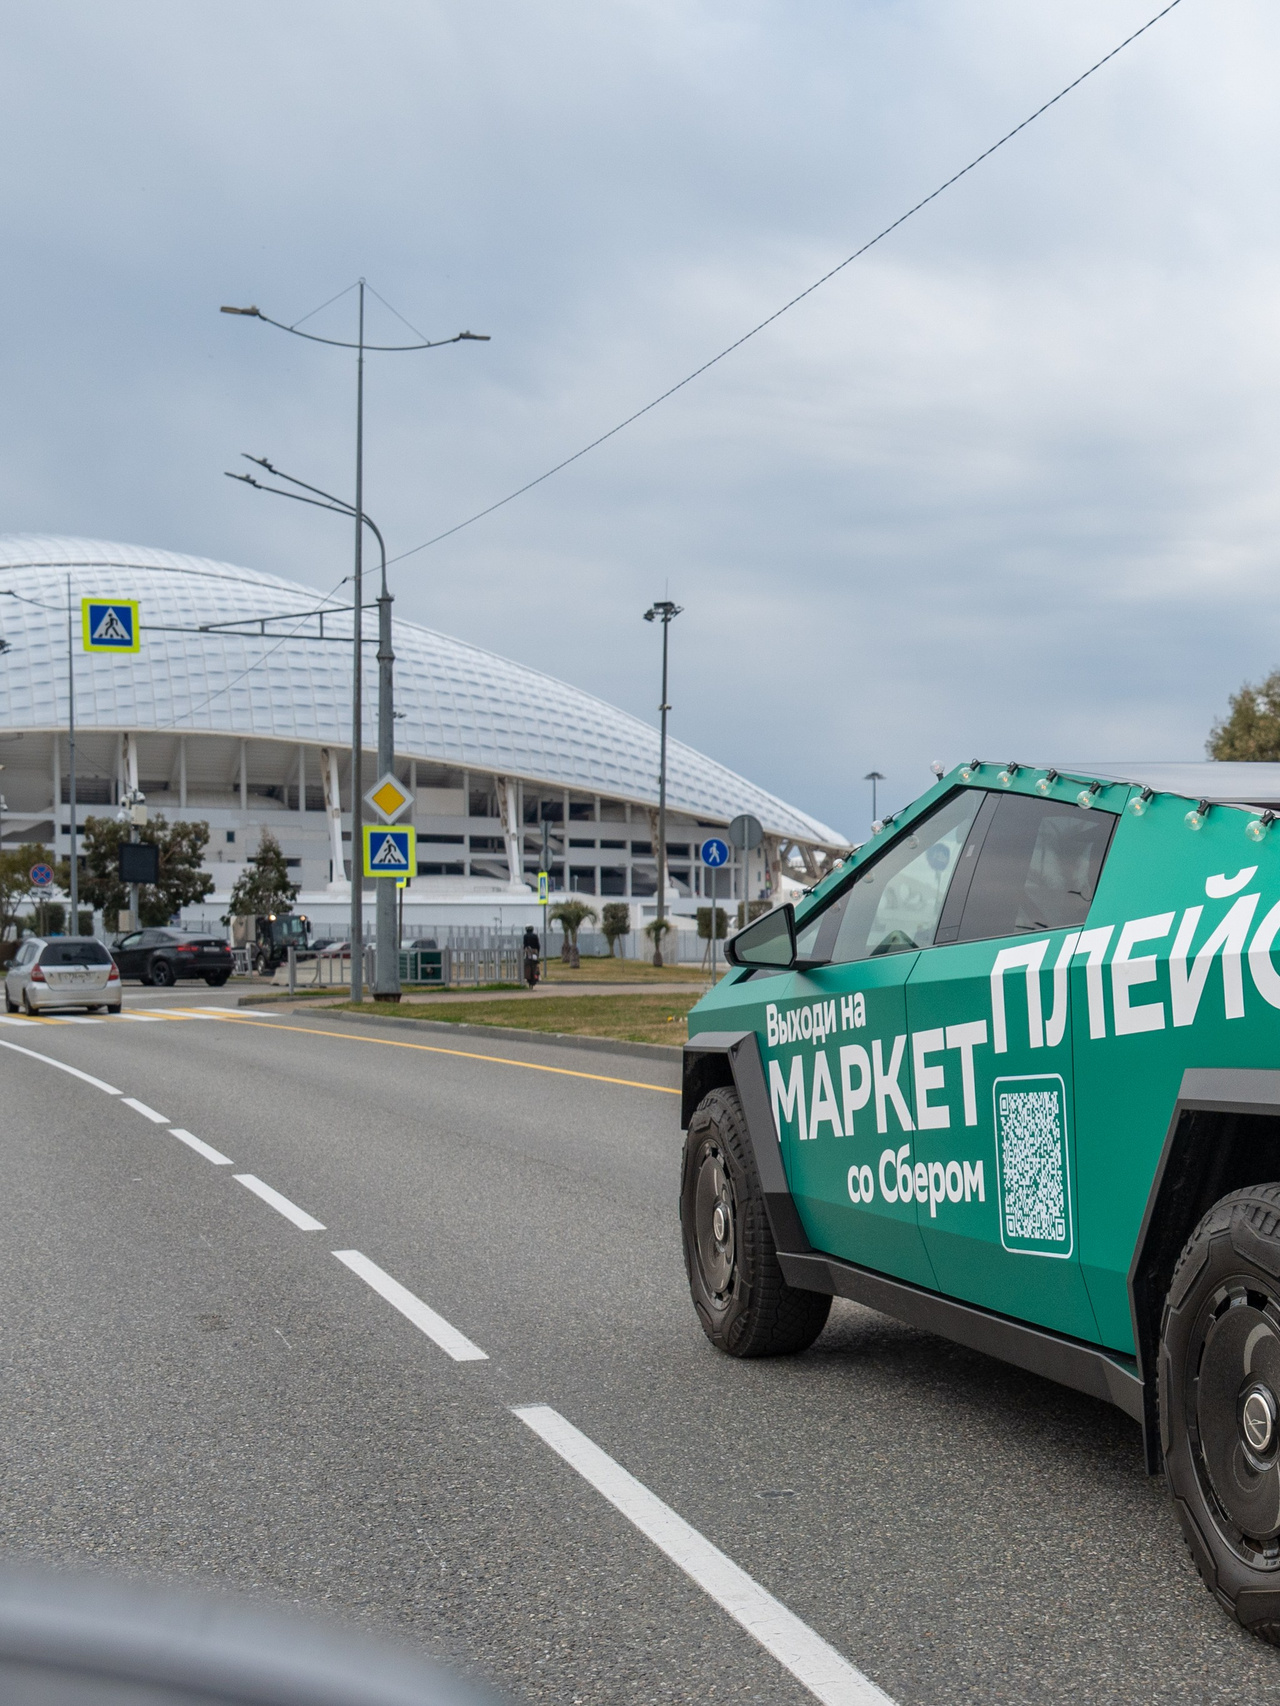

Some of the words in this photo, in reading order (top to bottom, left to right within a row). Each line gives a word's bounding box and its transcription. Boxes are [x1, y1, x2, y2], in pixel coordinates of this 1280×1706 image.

[766, 999, 837, 1048] Выходи
[841, 991, 867, 1031] на
[768, 1020, 988, 1143] МАРКЕТ
[847, 1164, 875, 1204] со
[879, 1144, 986, 1219] Сбером
